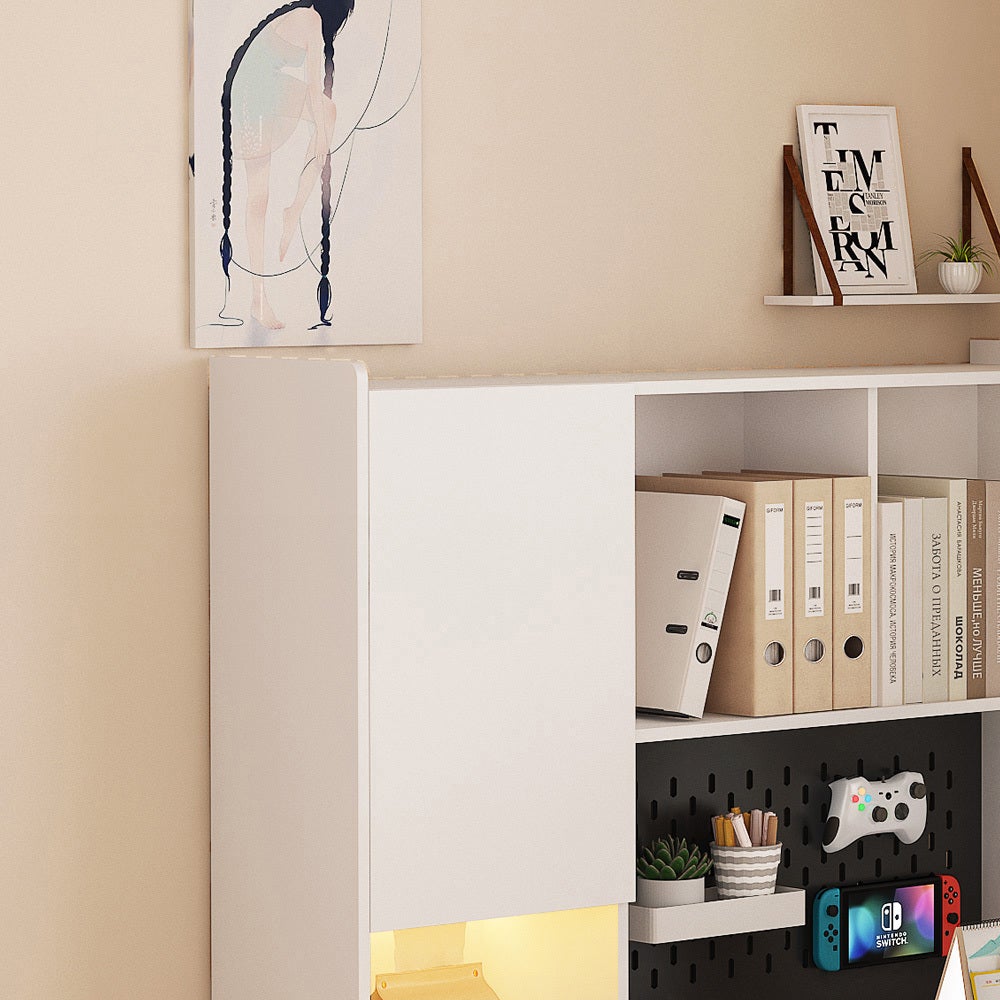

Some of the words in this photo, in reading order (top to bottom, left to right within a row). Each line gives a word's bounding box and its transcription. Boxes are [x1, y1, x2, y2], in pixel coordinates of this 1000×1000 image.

[889, 533, 897, 563] ИСТОРИЯ
[931, 533, 942, 580] ЗАБОТА
[932, 584, 942, 594] О
[889, 620, 897, 650] ИСТОРИЯ
[931, 597, 942, 678] ПРЕДАННЫХ
[954, 616, 963, 680] ШОКОЛАД
[889, 651, 897, 684] ЧЕЛОВЕКА
[972, 639, 983, 679] ЛУЧШЕ
[876, 931, 907, 940] NINTENDO
[876, 936, 907, 948] SWITCH
